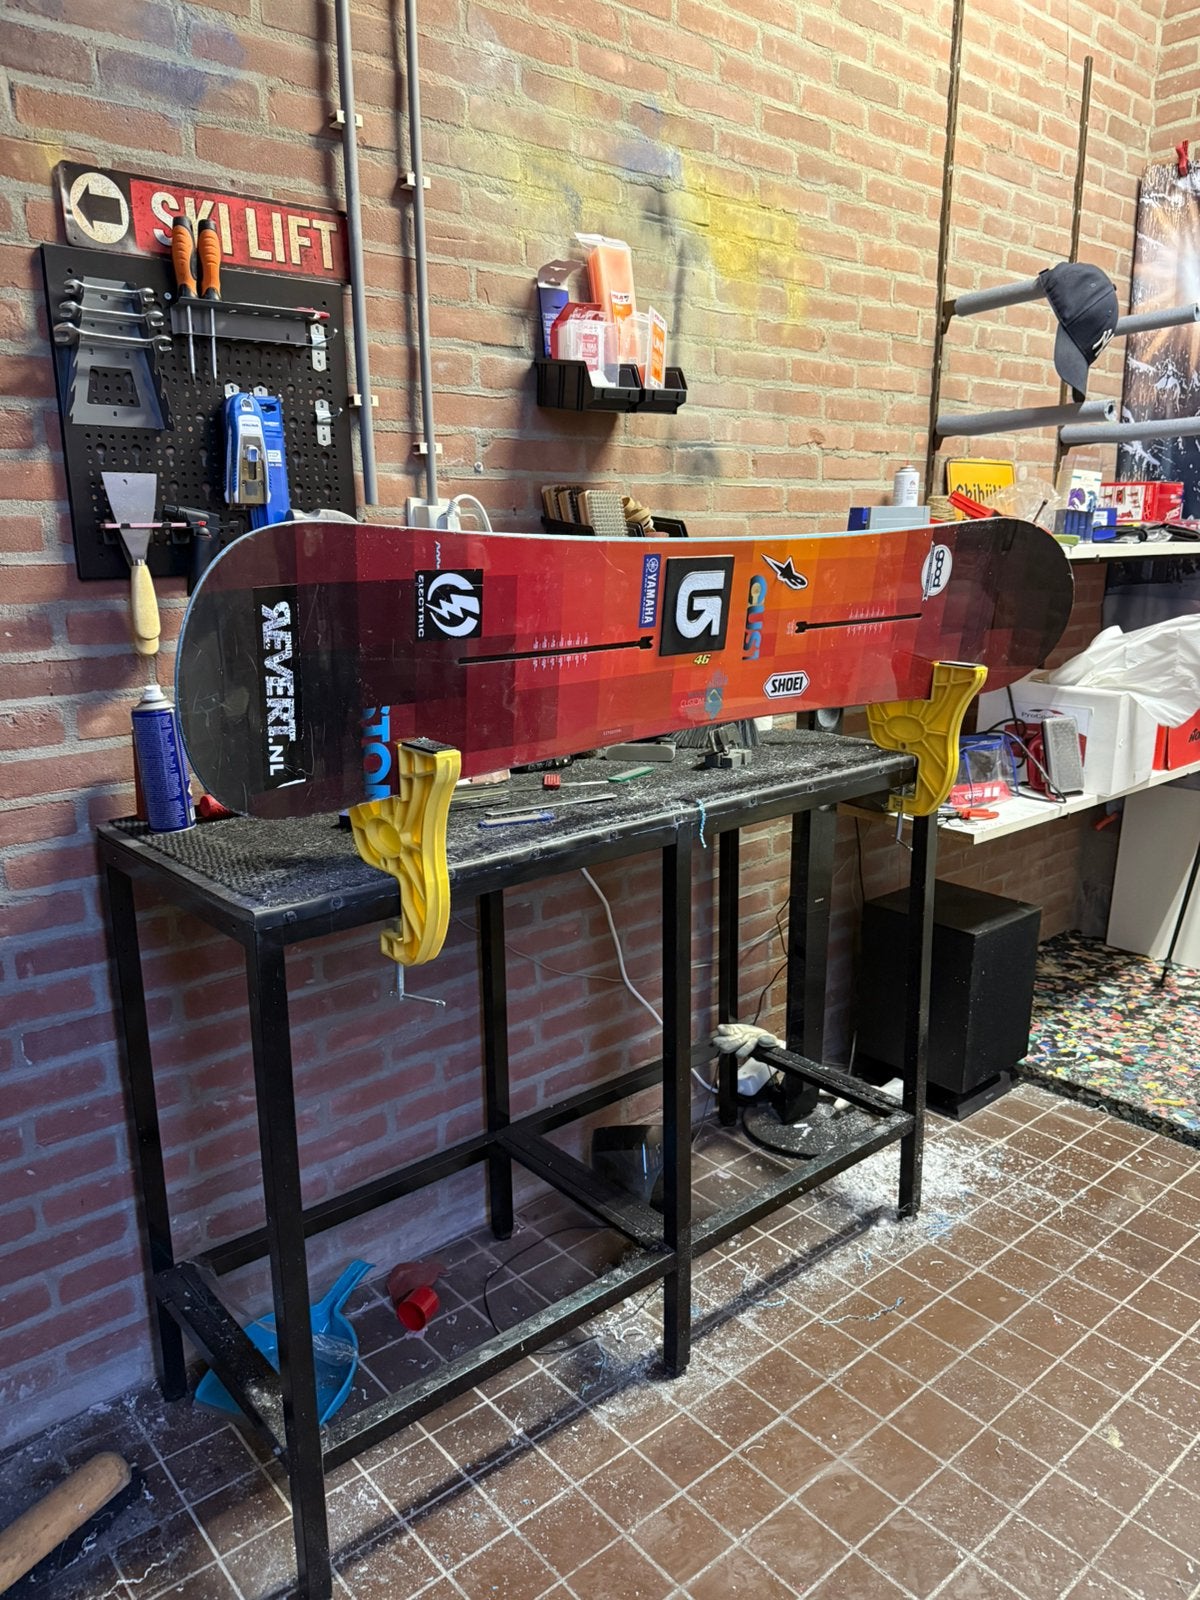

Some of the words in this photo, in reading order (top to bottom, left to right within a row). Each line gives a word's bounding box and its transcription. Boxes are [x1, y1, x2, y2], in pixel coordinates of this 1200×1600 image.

[151, 190, 235, 255] SKI
[244, 206, 338, 270] LIFT
[932, 549, 946, 588] good
[417, 574, 426, 638] ELECTRIC
[644, 573, 657, 624] YAMAHA
[693, 653, 711, 665] 46
[770, 675, 804, 693] SHOEI
